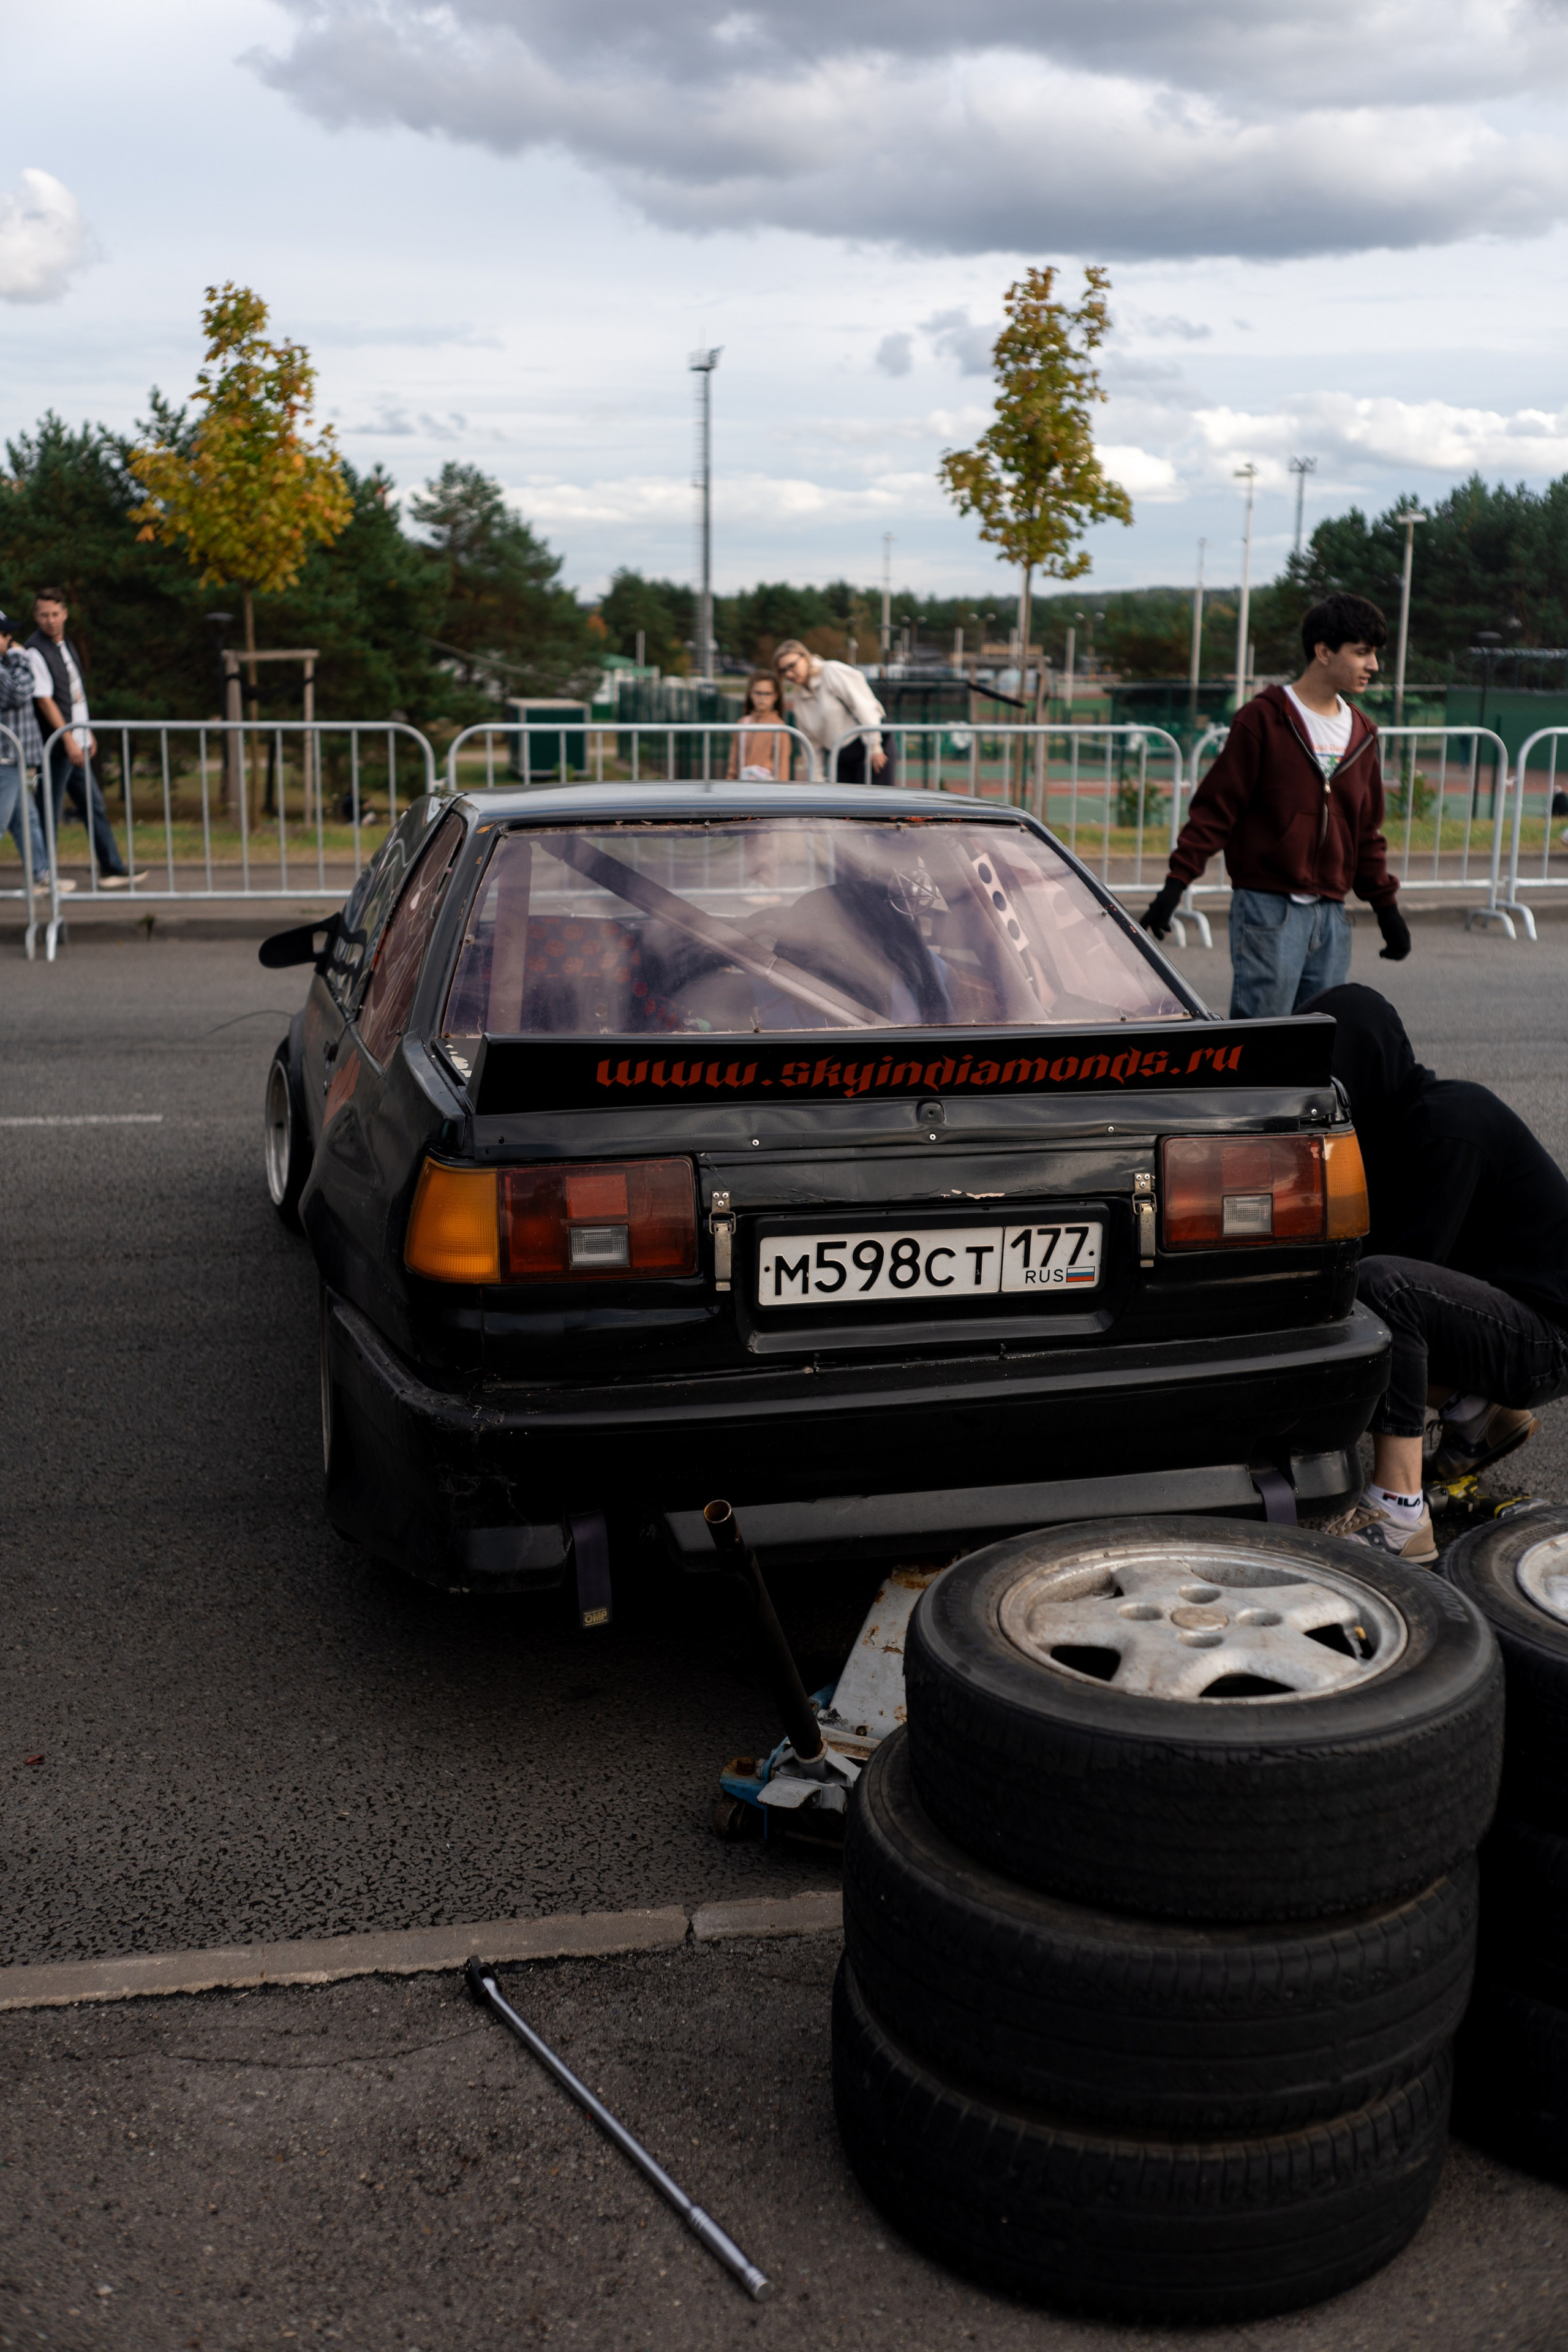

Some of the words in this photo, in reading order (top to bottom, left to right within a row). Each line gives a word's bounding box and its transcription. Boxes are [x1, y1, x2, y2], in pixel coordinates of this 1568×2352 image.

[596, 1045, 1244, 1098] www.skyindiamonds.ru
[1011, 1226, 1090, 1268] 177
[1025, 1269, 1065, 1284] RUS
[1382, 1491, 1421, 1507] FILA
[584, 1610, 608, 1623] OMP
